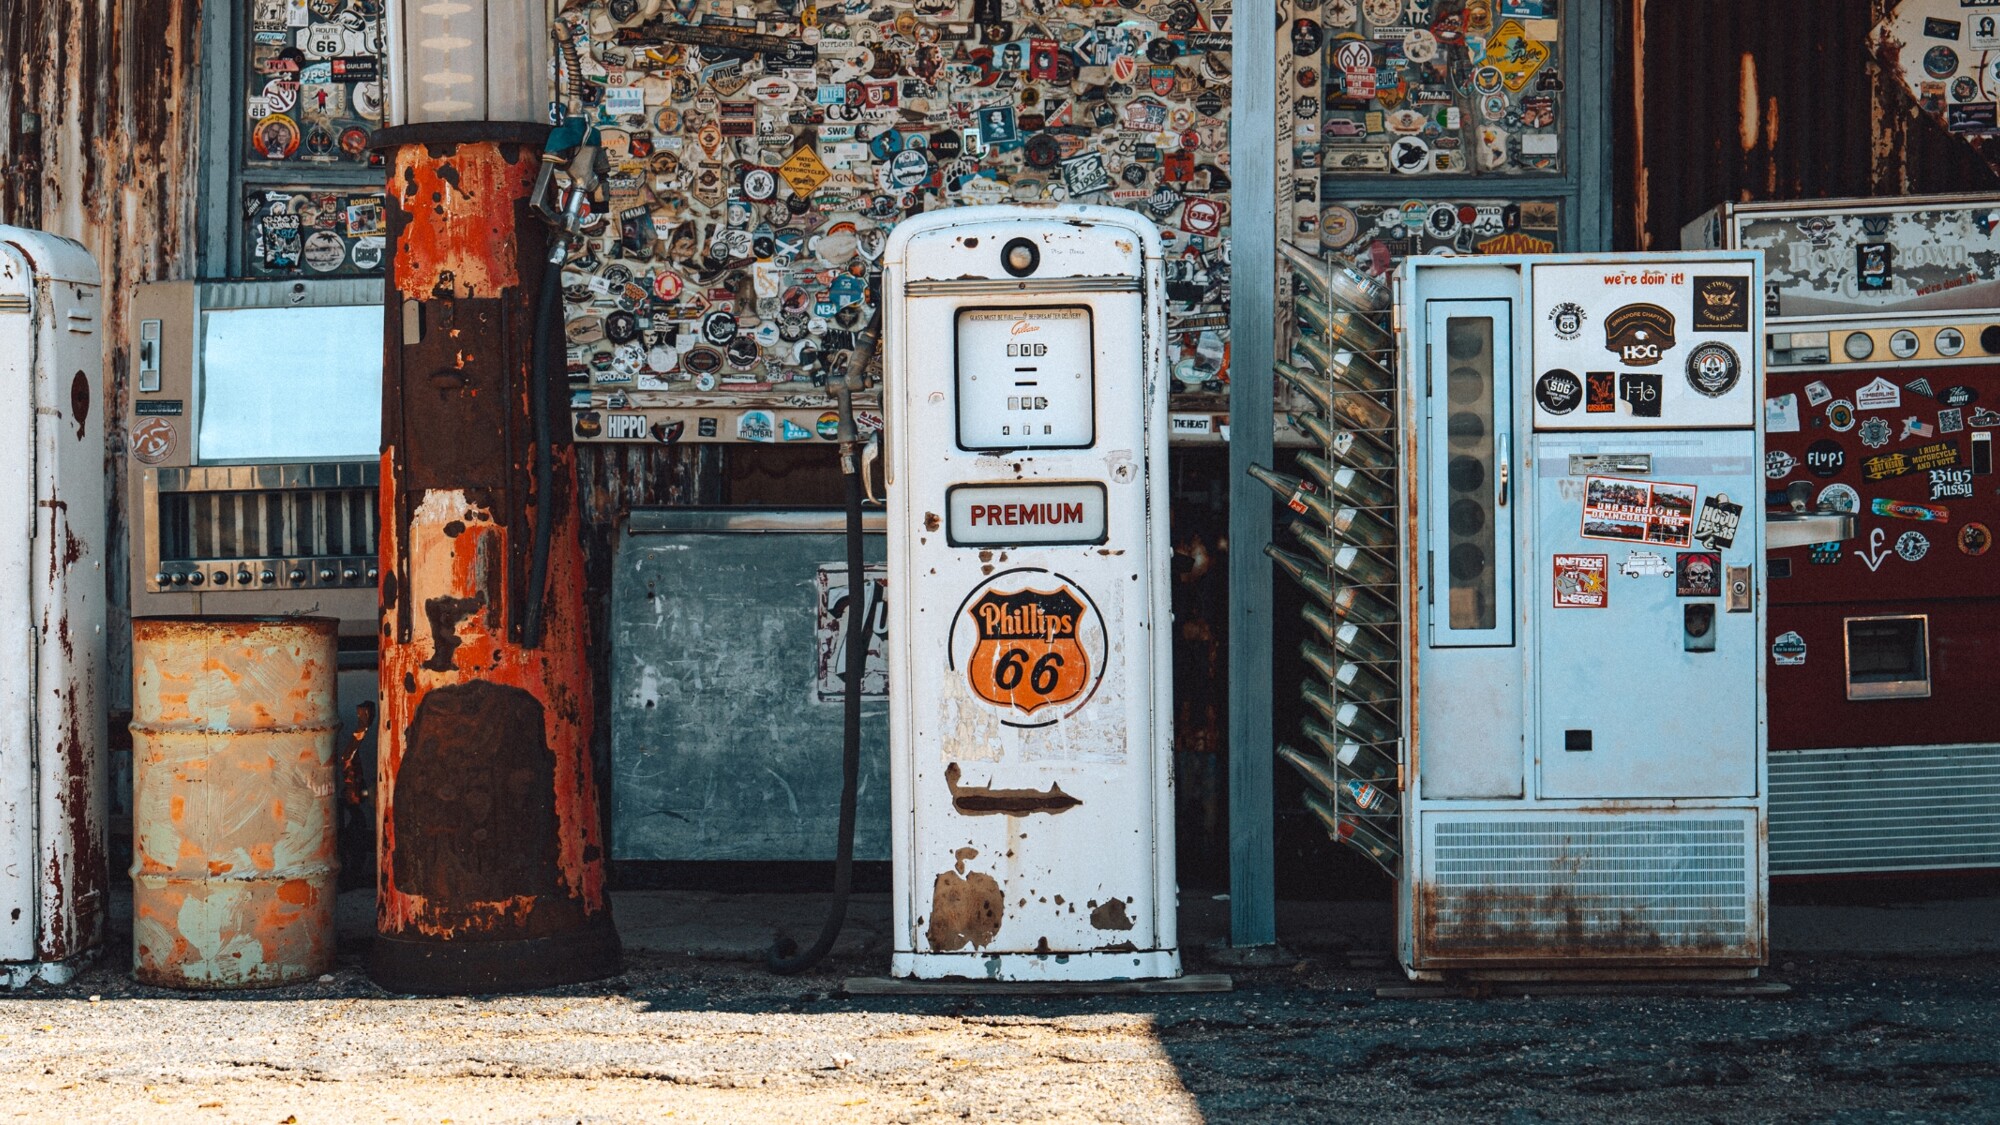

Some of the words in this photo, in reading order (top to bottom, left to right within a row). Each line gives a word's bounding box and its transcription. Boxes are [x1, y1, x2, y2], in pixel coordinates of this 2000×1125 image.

[316, 41, 336, 53] 66
[1192, 34, 1233, 48] Techniqu
[609, 75, 622, 84] 66
[827, 127, 847, 135] SWR
[784, 166, 826, 175] MOTORCYCLES
[1081, 170, 1102, 187] 1908
[1791, 244, 1857, 272] Roya
[1891, 244, 1967, 266] rown
[1604, 272, 1637, 285] we're
[1640, 272, 1668, 286] doin'
[1671, 272, 1684, 285] it!
[1916, 280, 1942, 297] we're
[1966, 273, 1977, 284] it!
[816, 305, 837, 315] N34
[1702, 309, 1735, 322] UZBEKISTAN
[1562, 322, 1575, 330] 66
[1611, 312, 1641, 327] SINGAPORE
[1642, 311, 1667, 324] CHAPTER
[1623, 345, 1657, 359] HOG
[1862, 390, 1895, 398] TIMBERLINE
[1947, 395, 1968, 403] JOINT
[608, 415, 646, 438] HIPPO
[1912, 448, 1957, 463] MOTORCYCLE
[1924, 444, 1941, 454] RIDE
[1917, 461, 1931, 471] AND
[1937, 457, 1956, 467] VOTE
[1930, 482, 1973, 500] Fussy
[970, 502, 1083, 526] PREMIUM
[1591, 510, 1604, 519] DA
[1597, 503, 1619, 512] UNA
[1887, 504, 1912, 512] PEOPLE
[1929, 510, 1948, 518] COOL
[1703, 505, 1738, 528] HOOD
[1556, 557, 1603, 567] KINETISCHE
[1561, 594, 1602, 605] ENERGIE!
[979, 602, 1073, 643] Phillips
[995, 648, 1064, 696] 66
